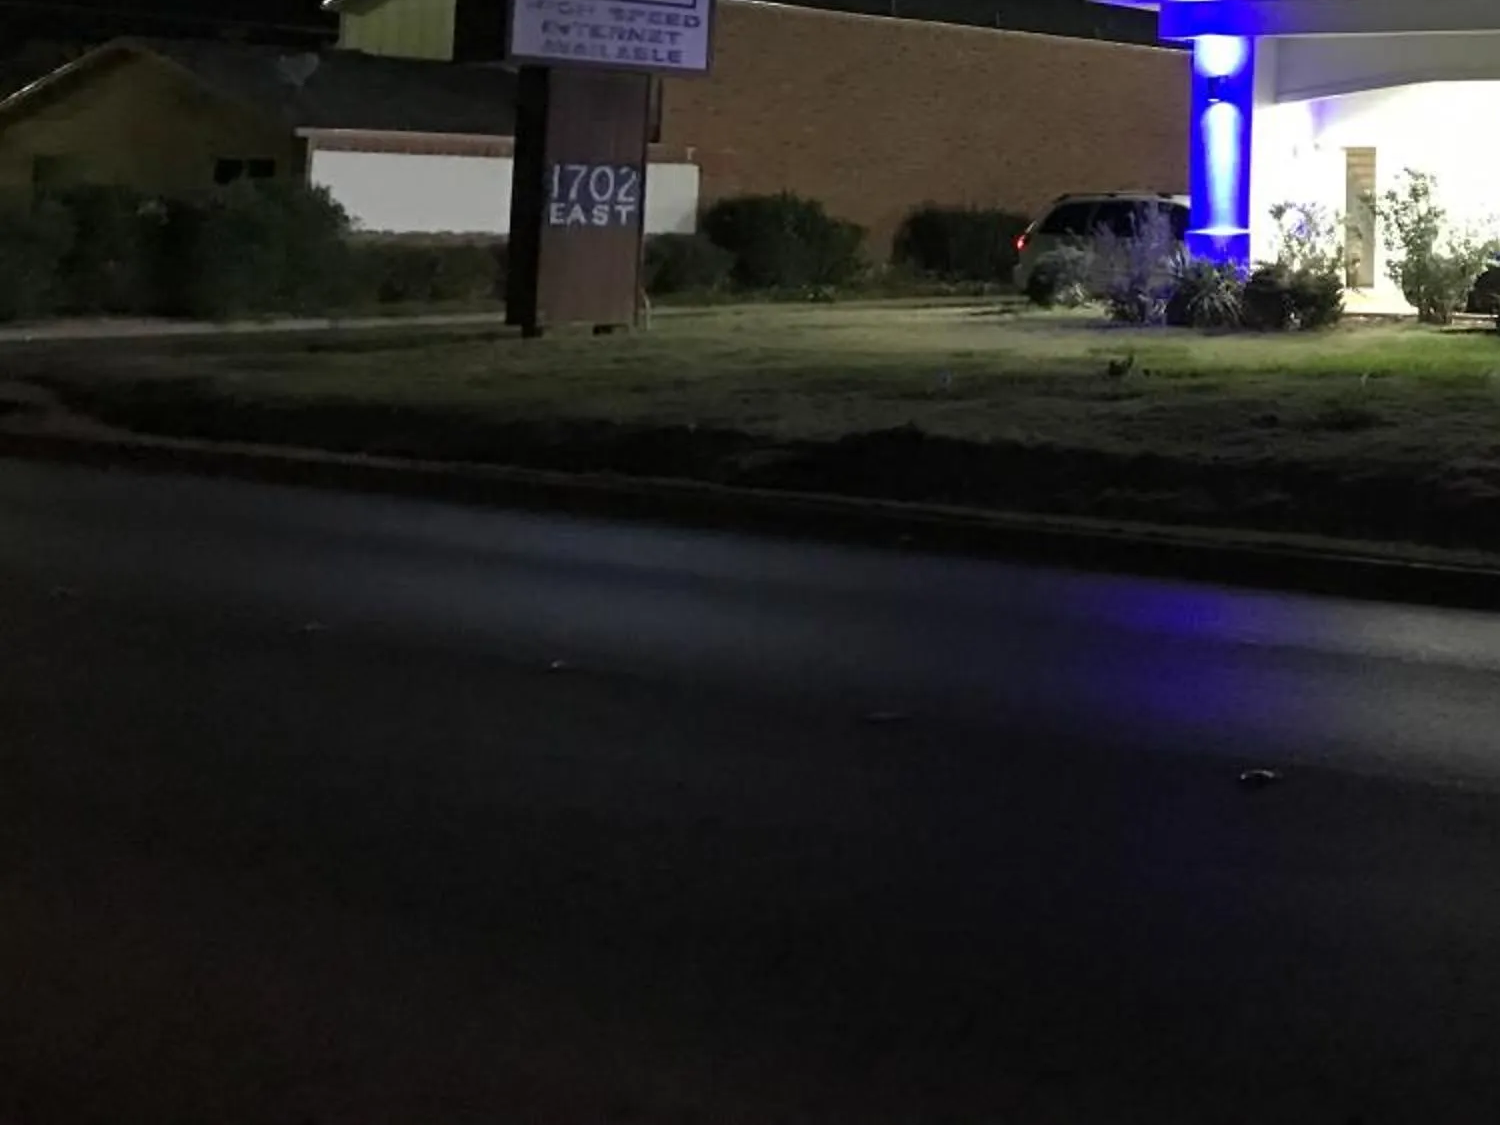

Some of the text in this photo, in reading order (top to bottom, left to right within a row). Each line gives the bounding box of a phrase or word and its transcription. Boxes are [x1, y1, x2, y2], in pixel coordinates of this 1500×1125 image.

[608, 6, 701, 28] SPEED
[541, 19, 683, 45] INTERNET
[551, 164, 638, 203] 1702
[550, 204, 635, 225] EAST
